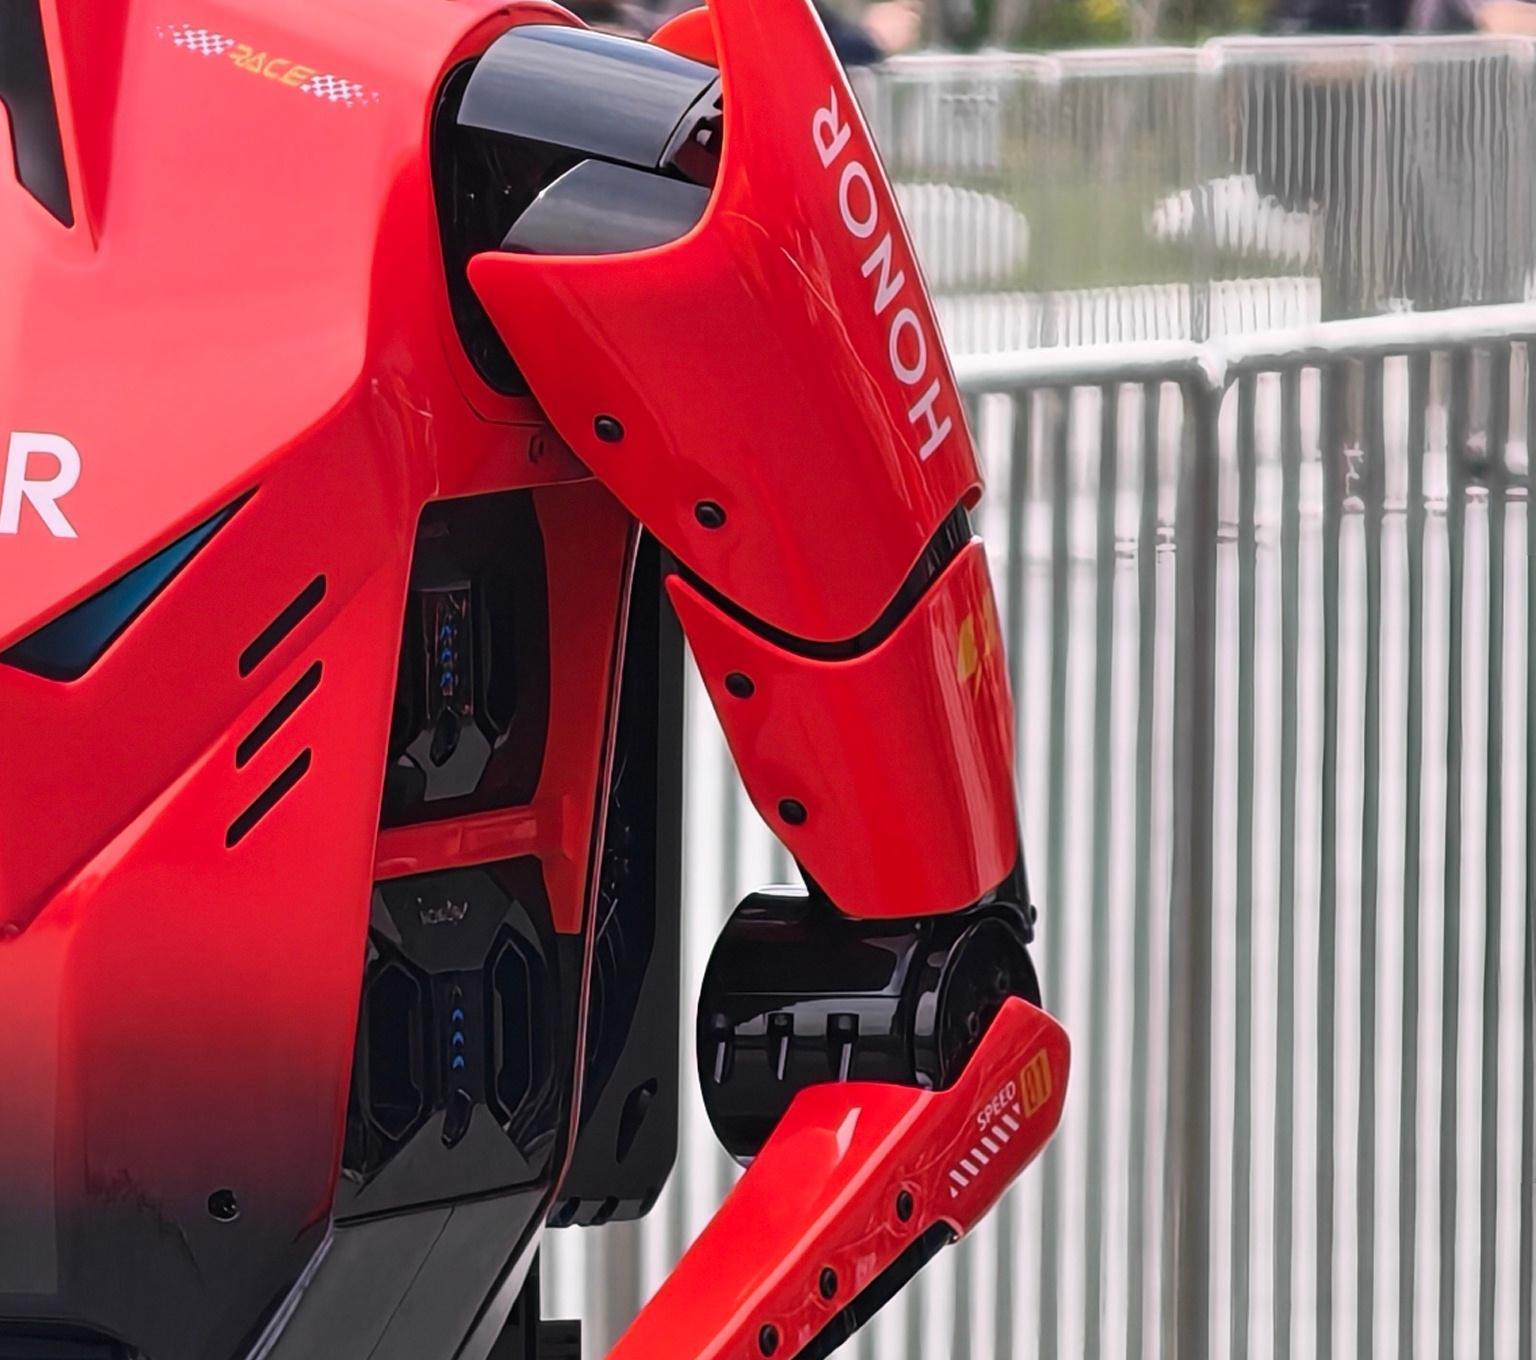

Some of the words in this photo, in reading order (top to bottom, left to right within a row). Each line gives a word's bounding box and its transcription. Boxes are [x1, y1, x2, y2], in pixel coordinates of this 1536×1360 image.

[229, 43, 317, 88] RACE
[811, 85, 953, 462] HONOR
[976, 1079, 1017, 1133] SPEED
